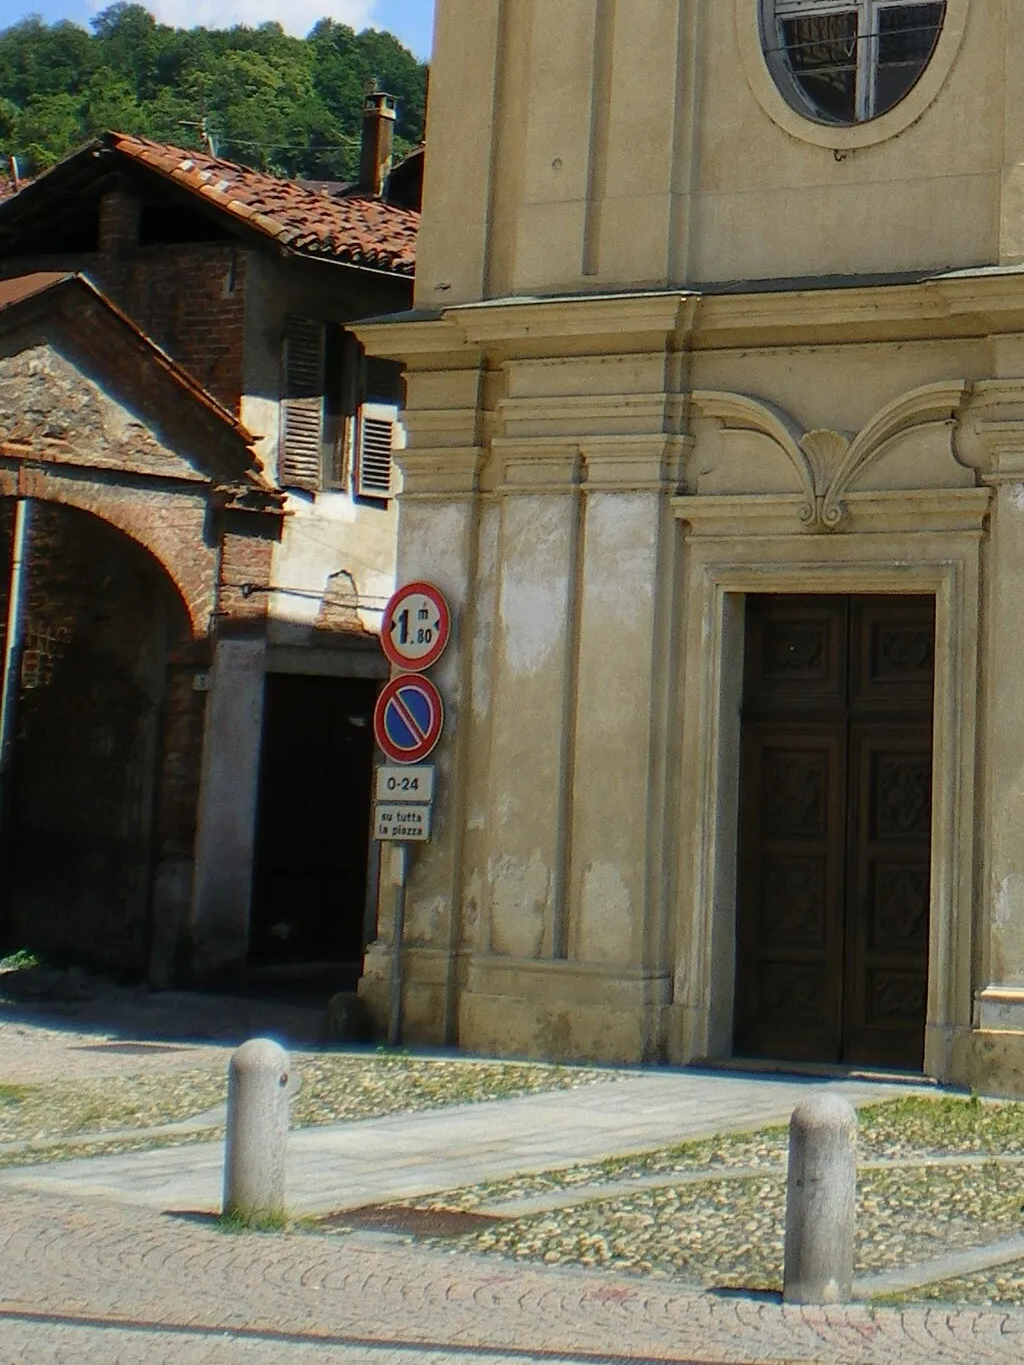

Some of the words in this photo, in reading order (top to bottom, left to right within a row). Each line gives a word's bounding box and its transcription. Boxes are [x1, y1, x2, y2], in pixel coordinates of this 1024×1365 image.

[387, 777, 419, 791] 0-24
[381, 813, 393, 822] su
[396, 812, 422, 822] tutta
[379, 825, 389, 835] la
[392, 826, 422, 836] piazza
